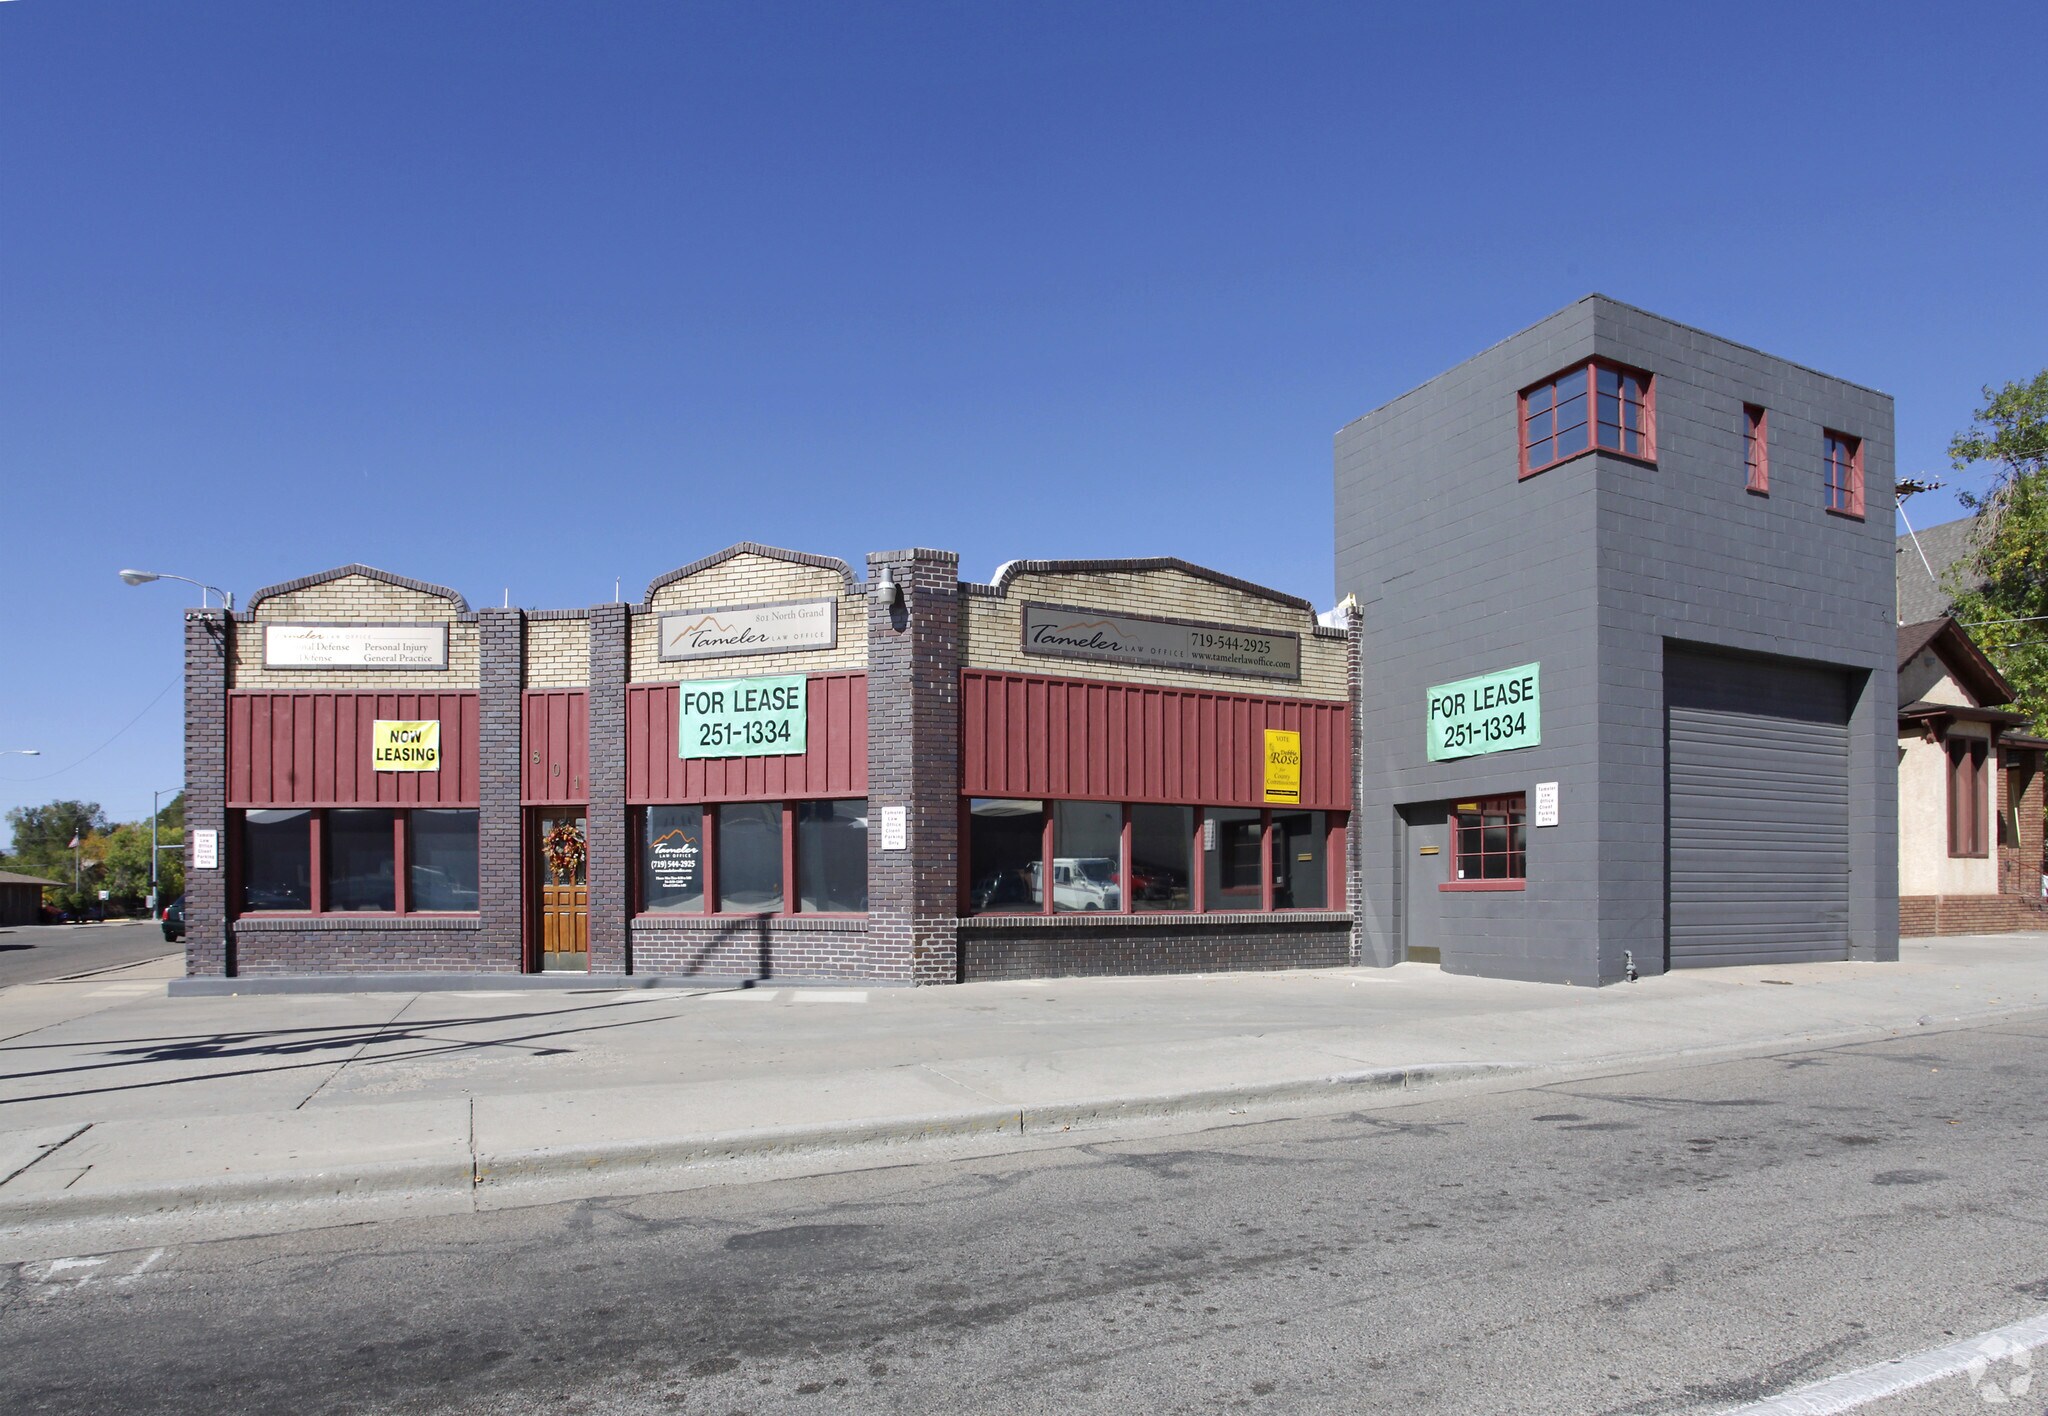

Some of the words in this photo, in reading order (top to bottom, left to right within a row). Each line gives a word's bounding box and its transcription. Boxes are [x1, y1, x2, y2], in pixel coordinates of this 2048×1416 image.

[771, 611, 796, 621] North
[798, 607, 824, 618] Grand
[689, 628, 770, 648] Tameler
[793, 632, 824, 640] OFFICE
[1031, 624, 1122, 651] Tameler
[1125, 645, 1145, 653] LAW
[1150, 647, 1184, 658] OFFICE
[1191, 632, 1271, 654] 719-544-2925
[316, 642, 350, 651] Defense
[364, 642, 400, 651] Personal
[402, 643, 428, 654] Injury
[363, 653, 397, 662] General
[398, 653, 433, 662] Practice
[1191, 651, 1291, 669] www.tamelerlawoffice.com
[684, 691, 725, 715] FOR
[734, 687, 799, 712] LEASE
[1431, 693, 1465, 720] FOR
[1473, 676, 1534, 711] LEASE
[390, 730, 421, 743] NOW
[700, 720, 791, 746] 251-1334
[1444, 712, 1527, 748] 251-1334
[376, 748, 435, 761] LEASING
[1271, 751, 1299, 765] Rose
[651, 860, 667, 869] (719)
[667, 860, 696, 868] 544-2925
